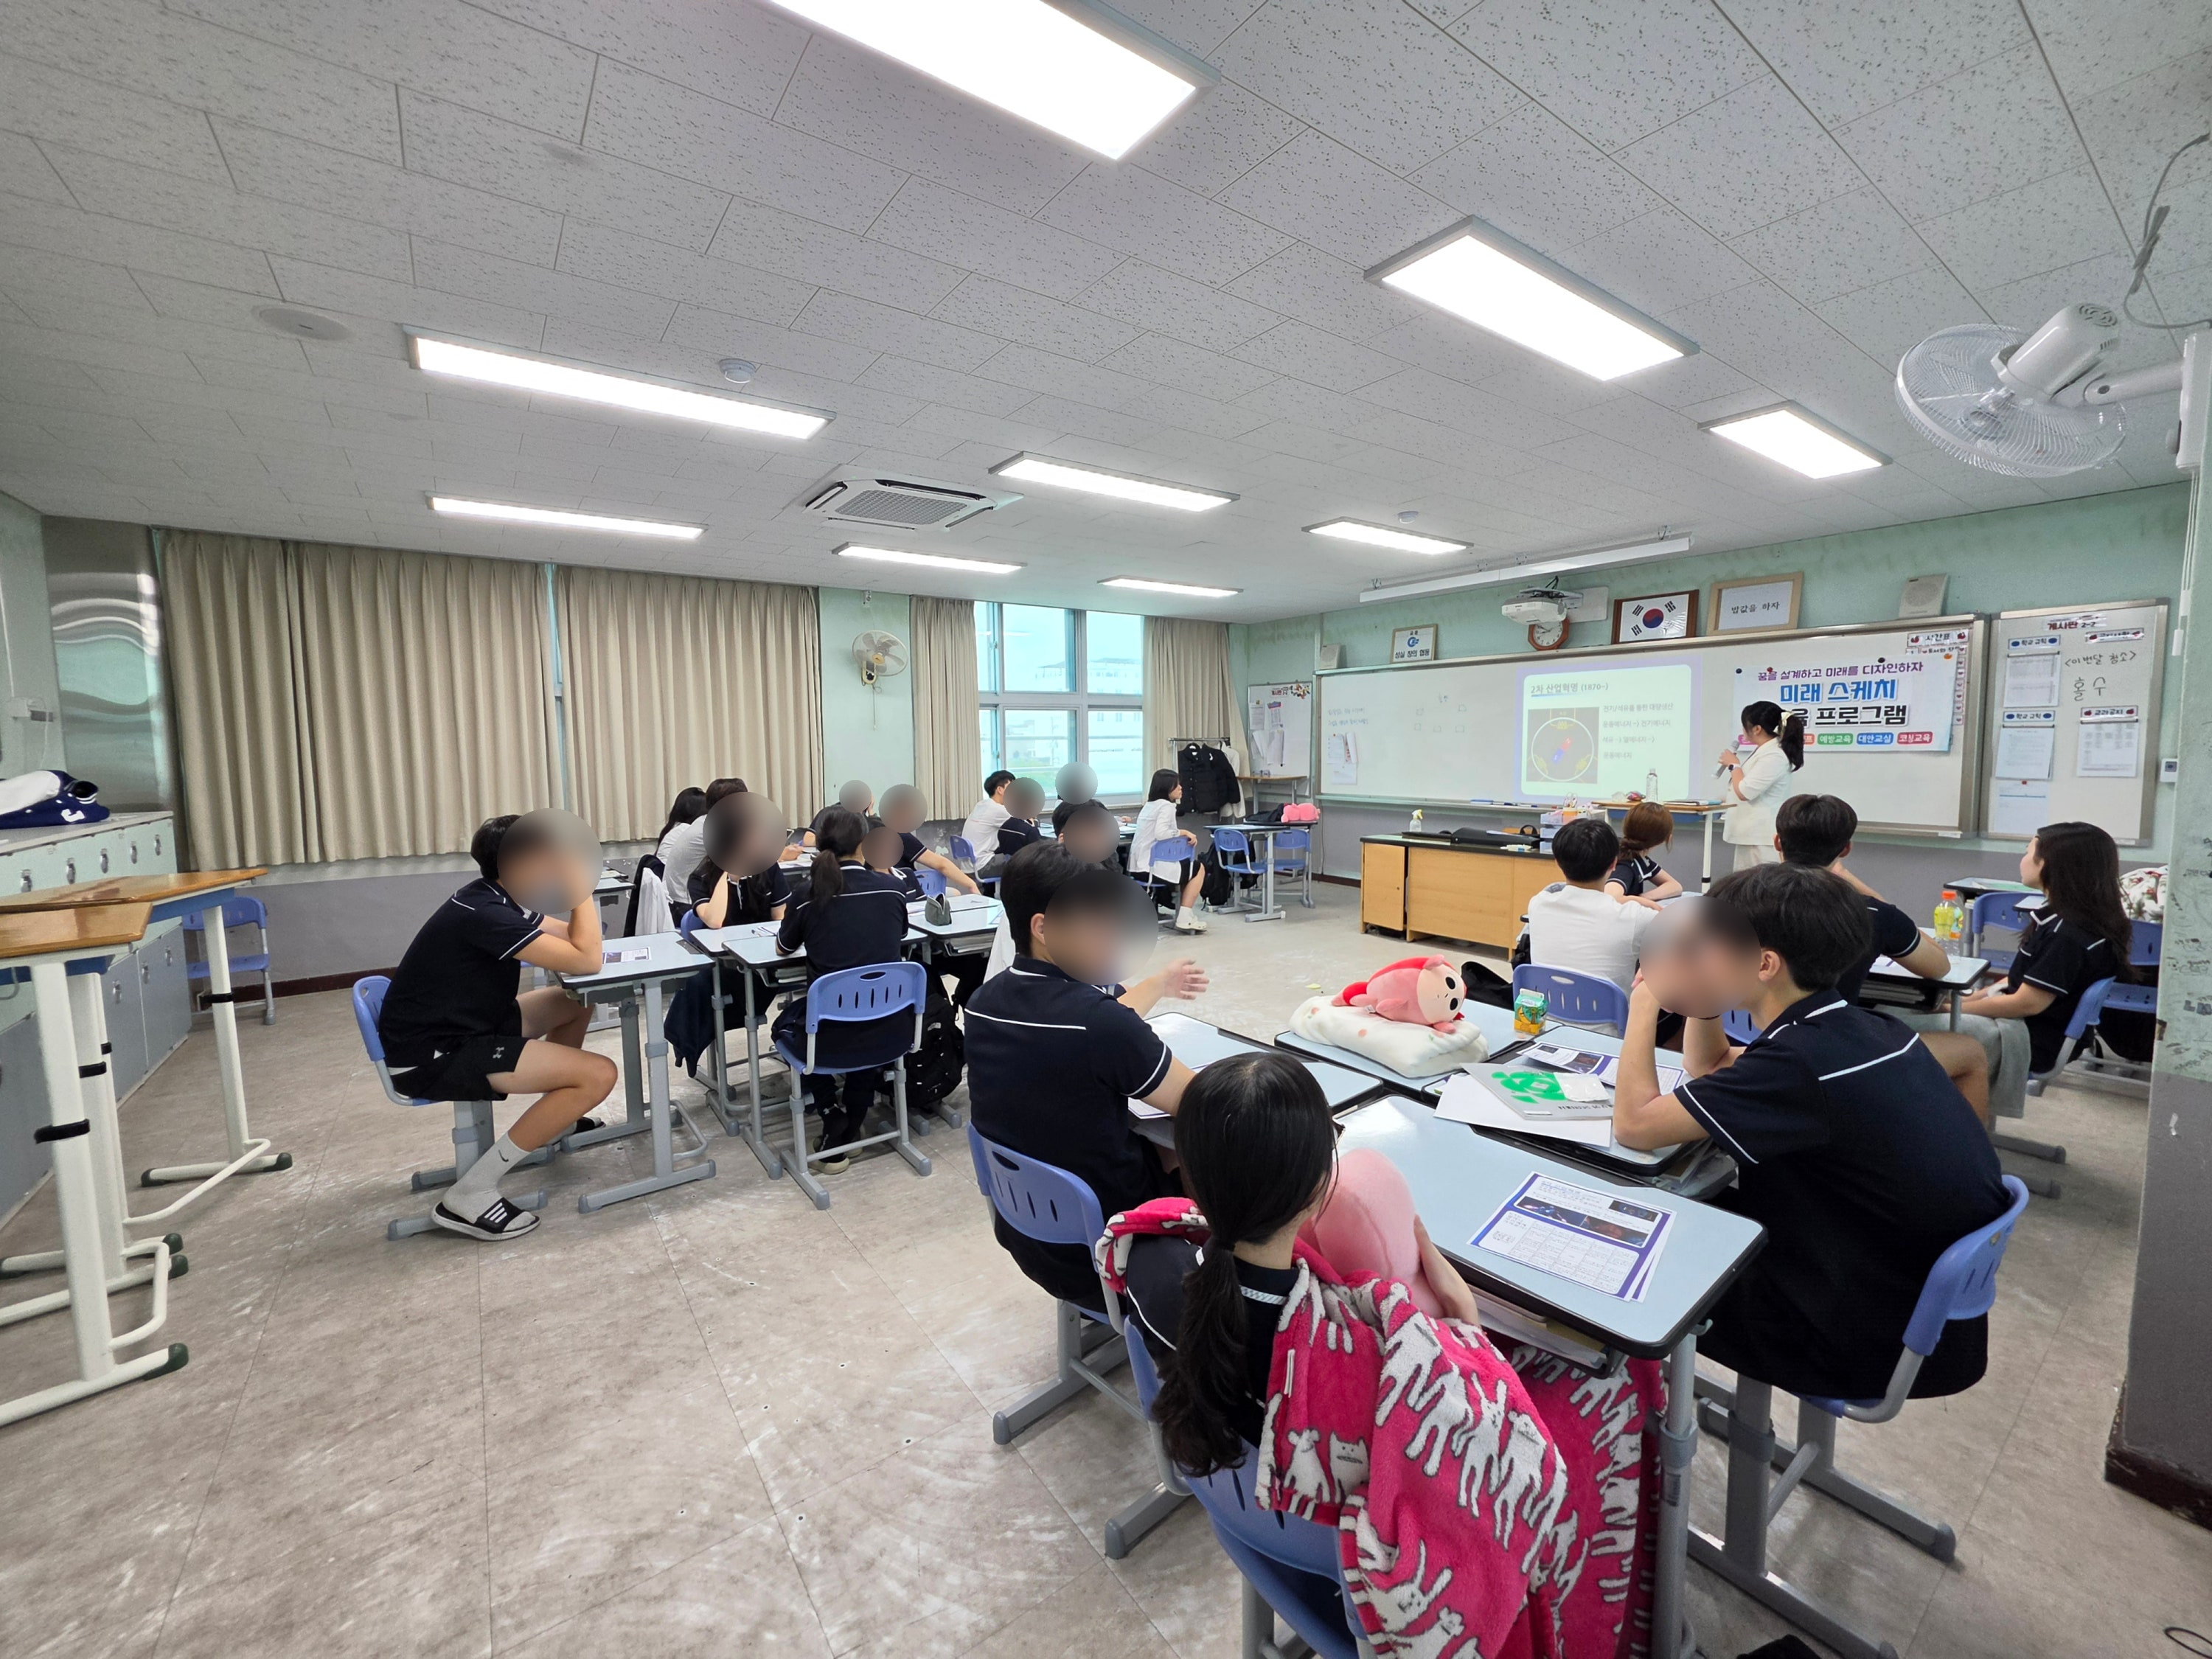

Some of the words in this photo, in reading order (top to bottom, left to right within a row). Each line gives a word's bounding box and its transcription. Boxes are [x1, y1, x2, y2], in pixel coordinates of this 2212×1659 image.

[1731, 604, 1757, 613] 밥값을
[1762, 601, 1780, 611] 하자
[2048, 622, 2078, 630] 게시판
[1758, 672, 1777, 681] 꿈을
[1781, 669, 1821, 680] 설계하고
[1826, 666, 1858, 677] 미래를
[1863, 661, 1924, 675] 디자인하자
[1546, 683, 1578, 693] 산업혁명
[1781, 683, 1820, 703] 미래
[1828, 679, 1896, 700] 스케치
[1815, 705, 1907, 725] 프로그램
